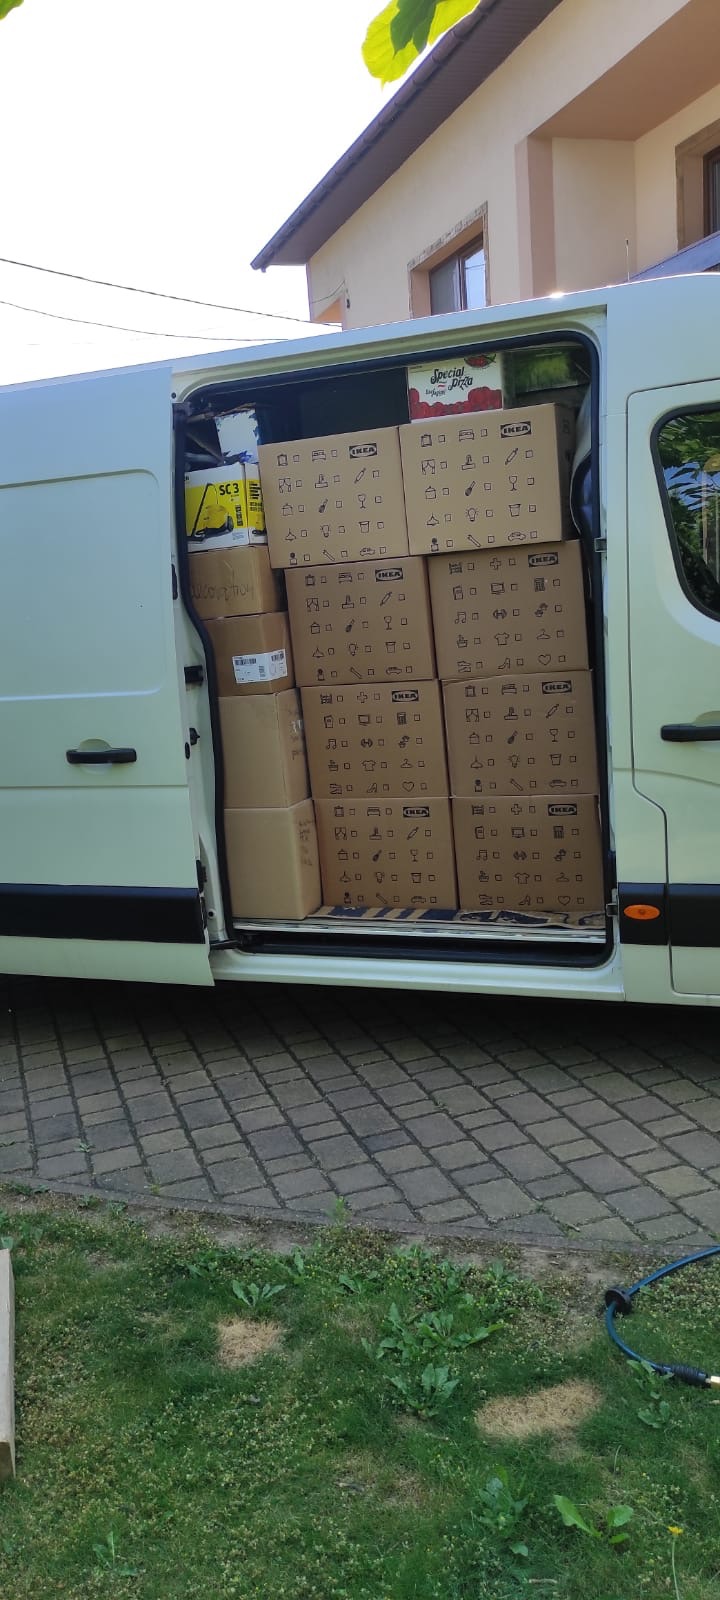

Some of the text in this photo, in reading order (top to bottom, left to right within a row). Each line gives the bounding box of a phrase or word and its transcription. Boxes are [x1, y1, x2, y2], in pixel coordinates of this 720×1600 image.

[431, 366, 465, 385] Special
[502, 424, 530, 435] IKEA
[351, 446, 376, 455] IKEA
[219, 483, 240, 496] SC 3
[530, 554, 557, 565] IKEA
[377, 570, 402, 579] IKEA
[544, 683, 570, 692] IKEA
[393, 692, 417, 700] IKEA
[405, 808, 428, 816] IKEA
[550, 805, 575, 814] IKEA
